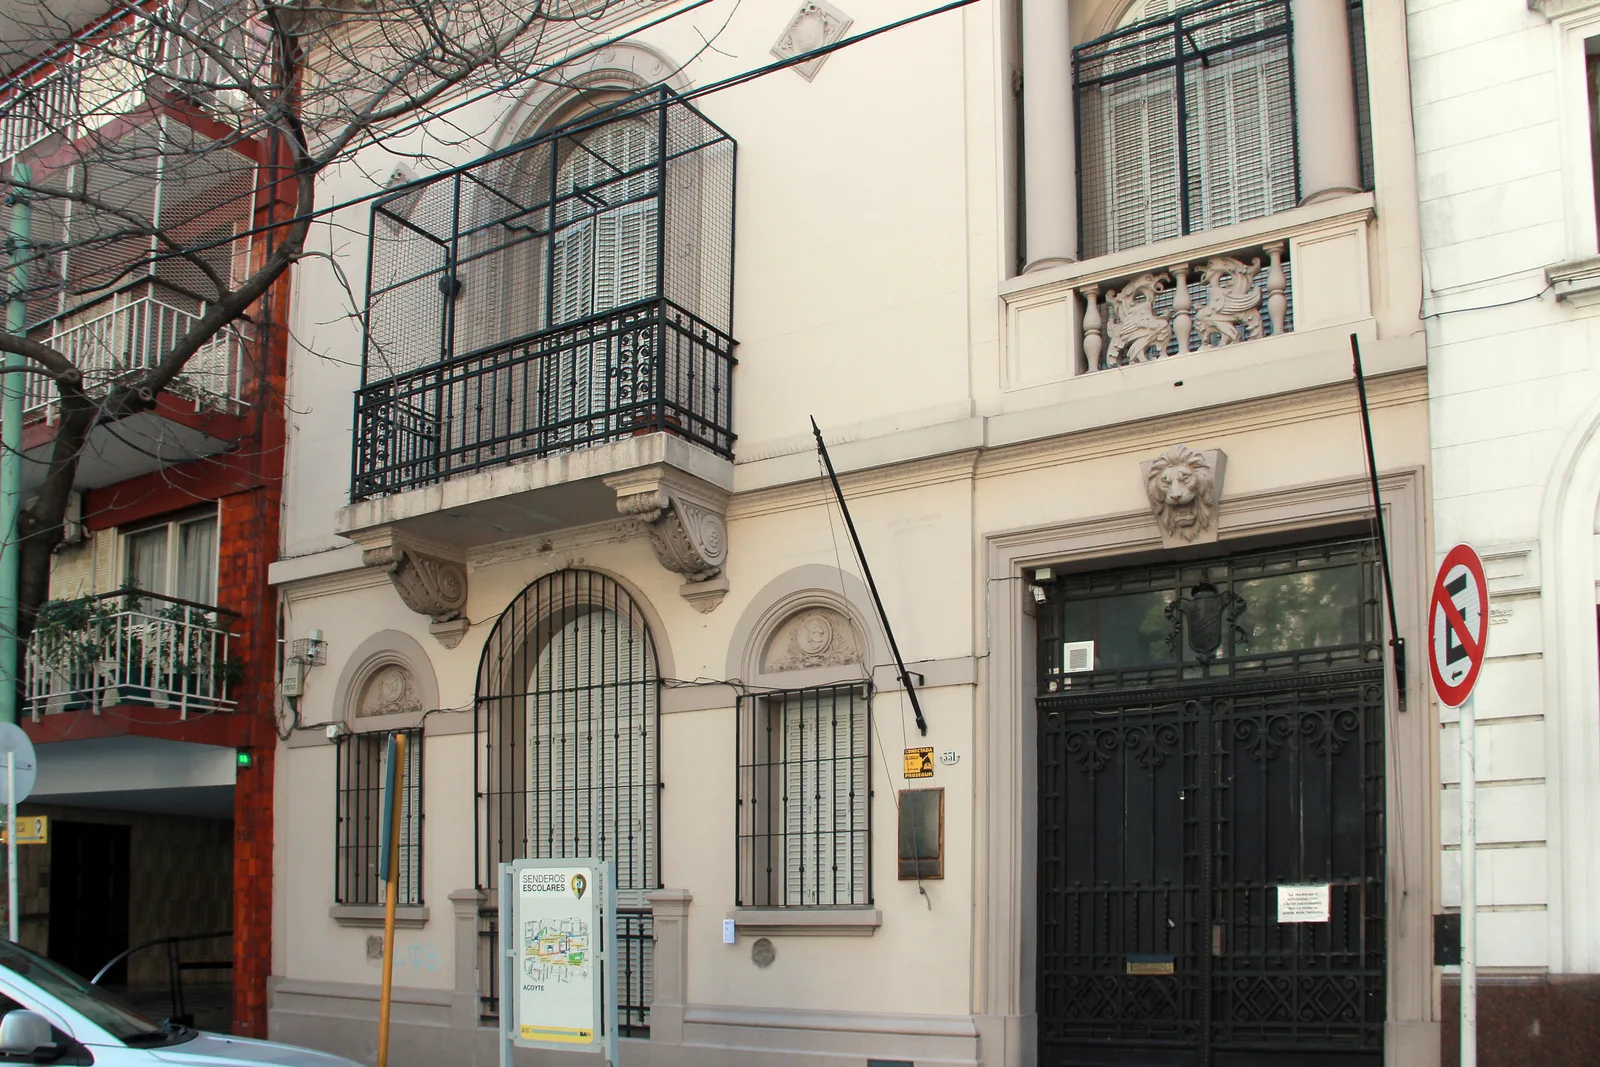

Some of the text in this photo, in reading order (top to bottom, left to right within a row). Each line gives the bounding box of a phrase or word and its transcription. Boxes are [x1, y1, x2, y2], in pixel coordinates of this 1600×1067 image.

[943, 751, 956, 762] 551
[522, 873, 566, 884] SENDEROS
[522, 883, 566, 892] ESCOLARES
[522, 984, 545, 992] ACOYTE
